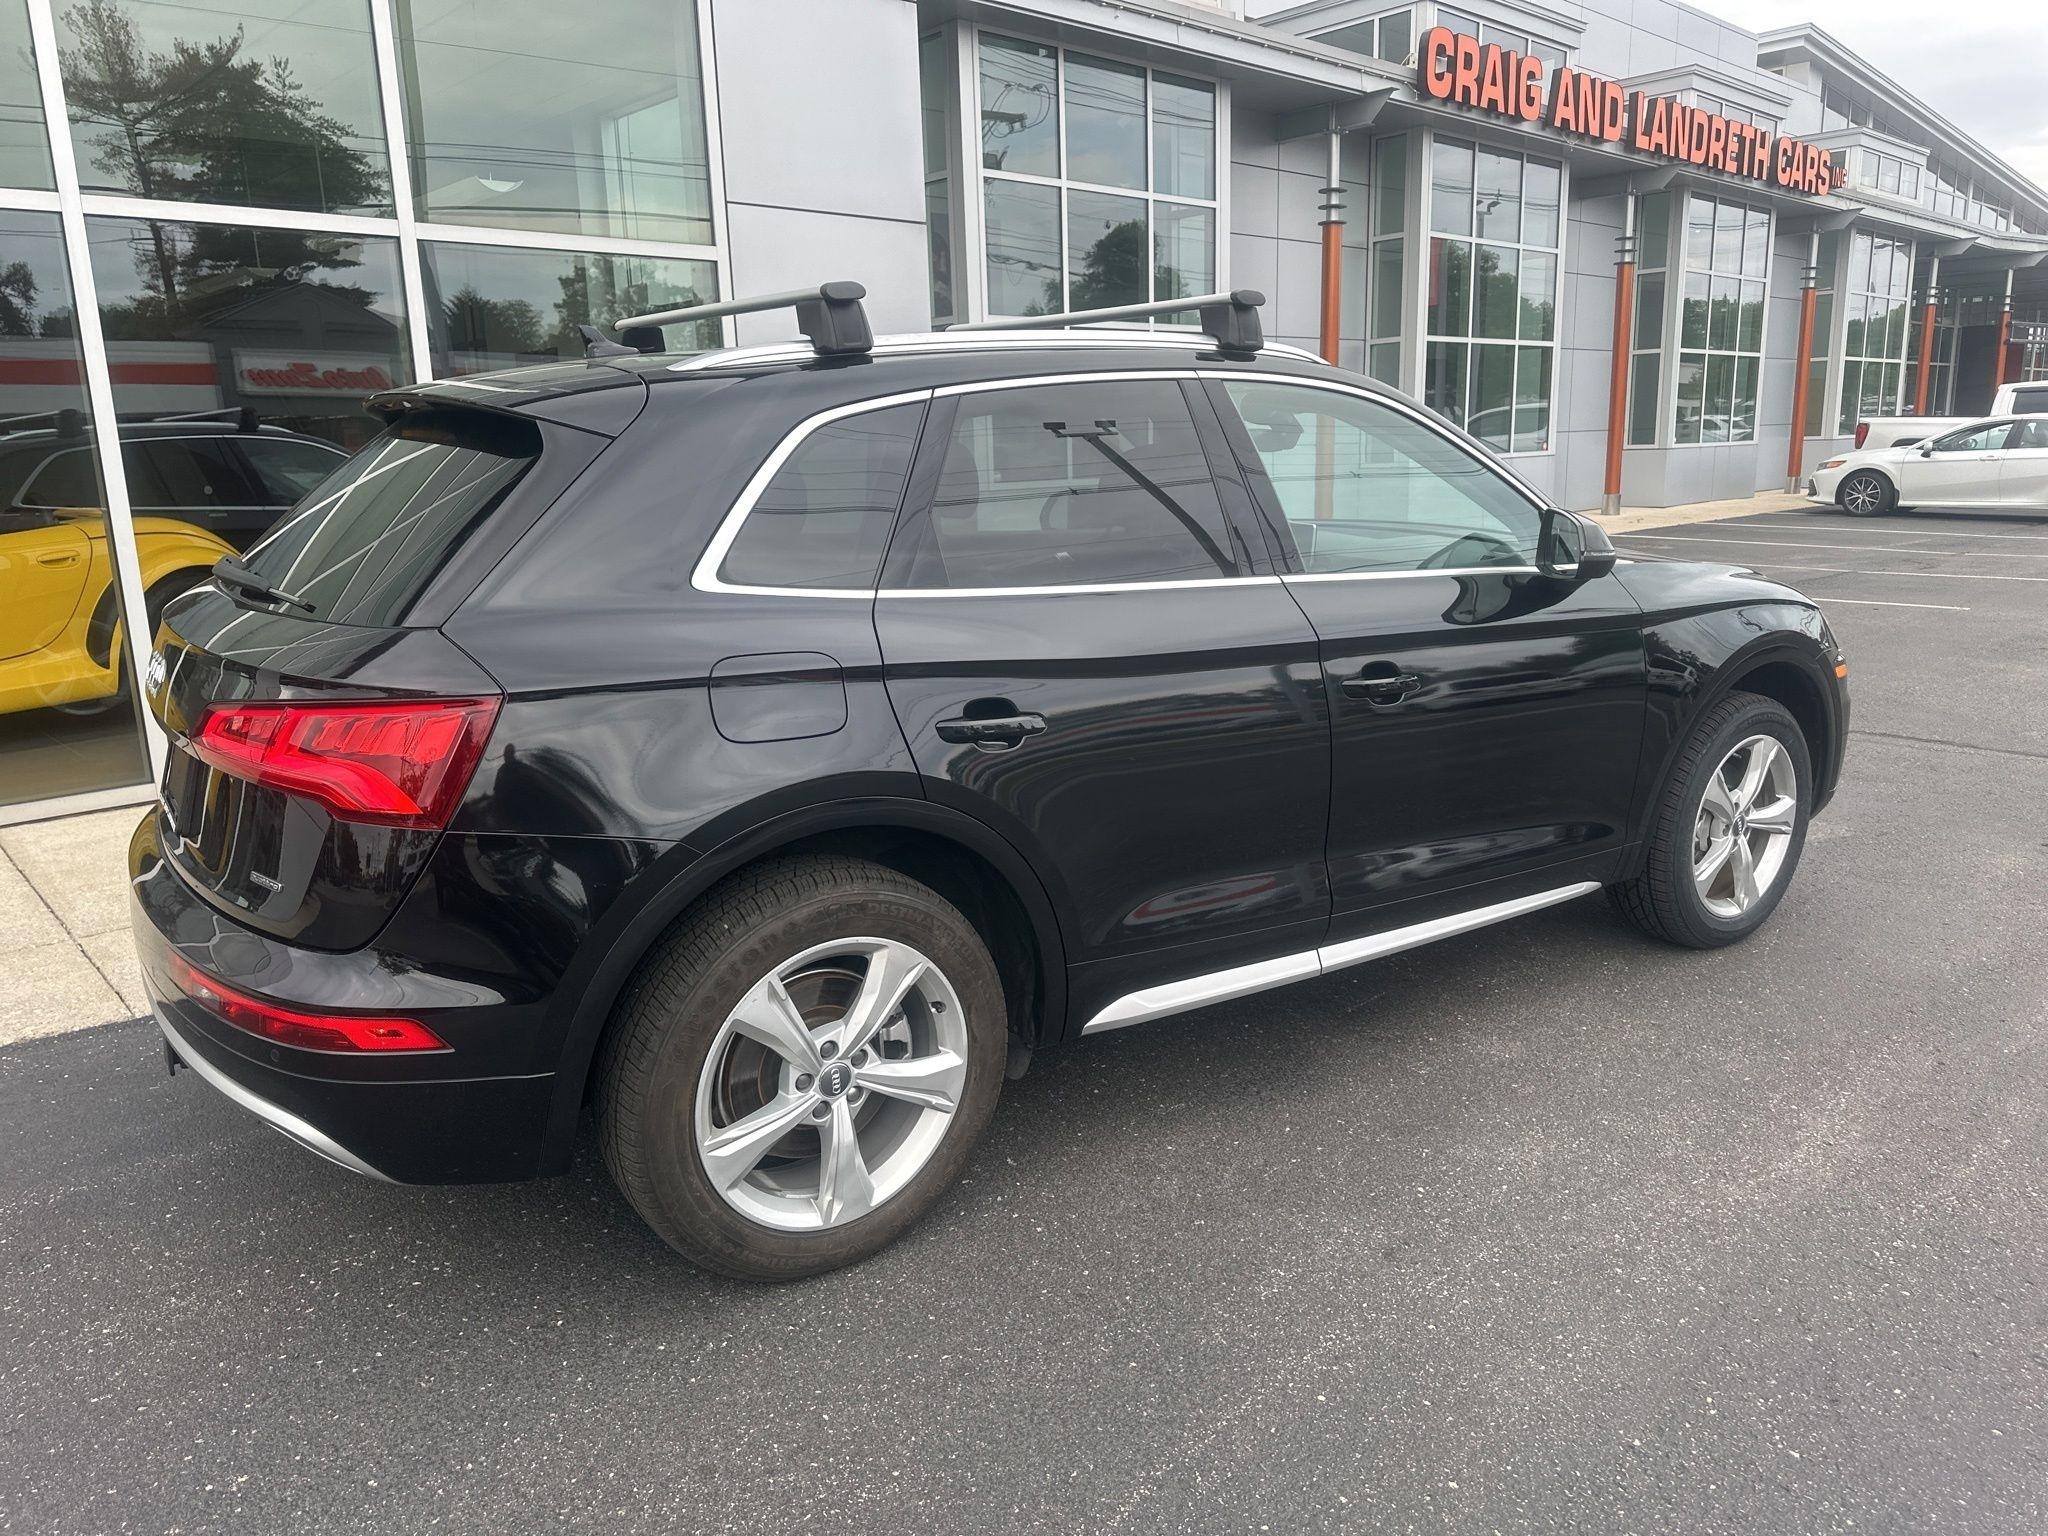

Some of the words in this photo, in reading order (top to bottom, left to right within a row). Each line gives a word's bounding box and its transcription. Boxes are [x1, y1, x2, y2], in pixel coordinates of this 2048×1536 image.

[1420, 26, 1543, 121] CRAIG
[1548, 67, 1625, 143] AND
[1629, 90, 1772, 182] LANDRETH
[1772, 136, 1832, 196] CARS
